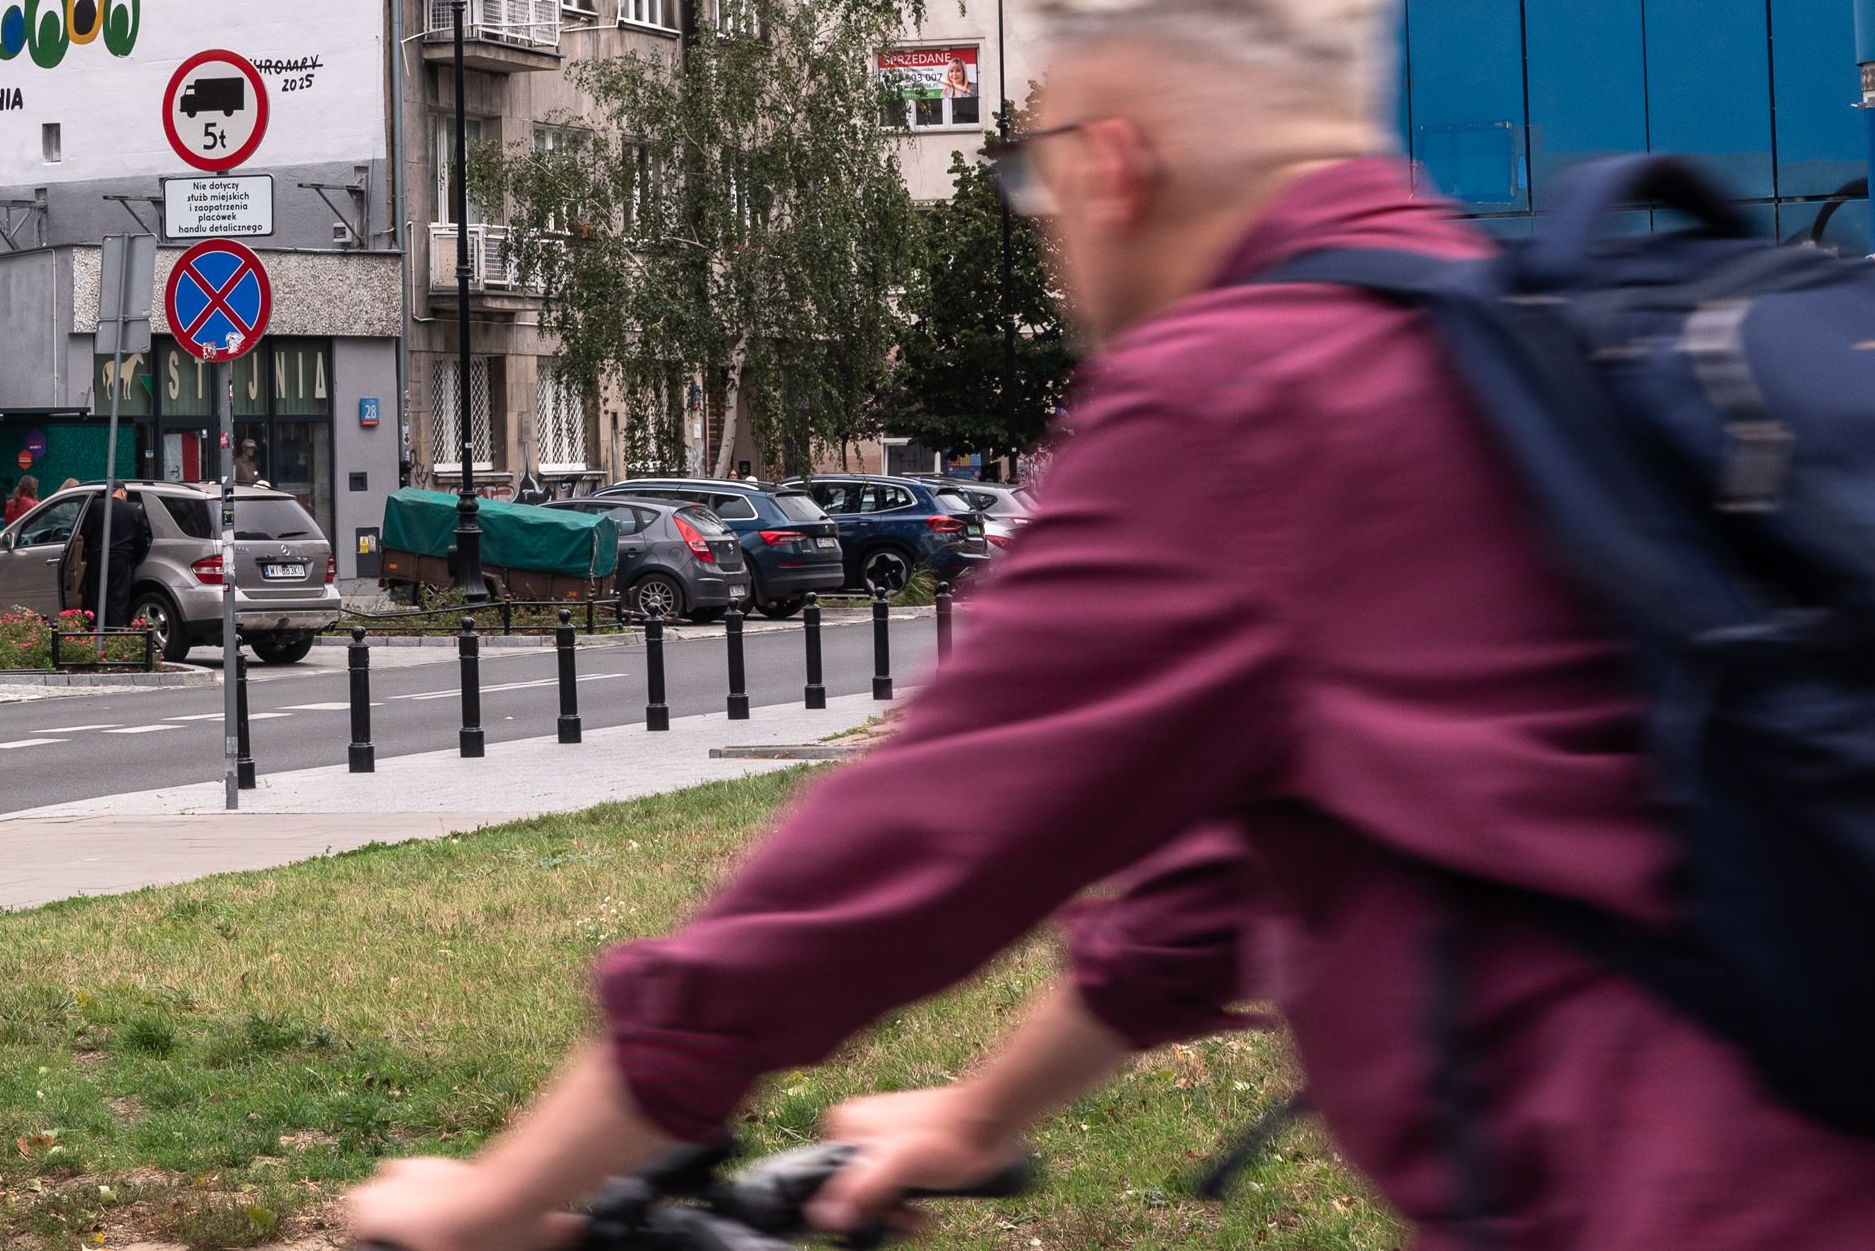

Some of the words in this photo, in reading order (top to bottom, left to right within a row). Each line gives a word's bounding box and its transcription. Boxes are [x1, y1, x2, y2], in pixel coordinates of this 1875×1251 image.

[282, 74, 314, 92] 2025
[193, 182, 207, 191] Nie
[211, 181, 239, 191] dotyczy
[187, 193, 208, 202] służb
[210, 192, 249, 203] miejskich
[194, 202, 248, 213] zaopatrzenia
[198, 213, 237, 223] placówek
[179, 224, 207, 234] handlu
[209, 223, 263, 234] detalicznego
[168, 350, 327, 400] STJNIA
[365, 404, 376, 419] 28
